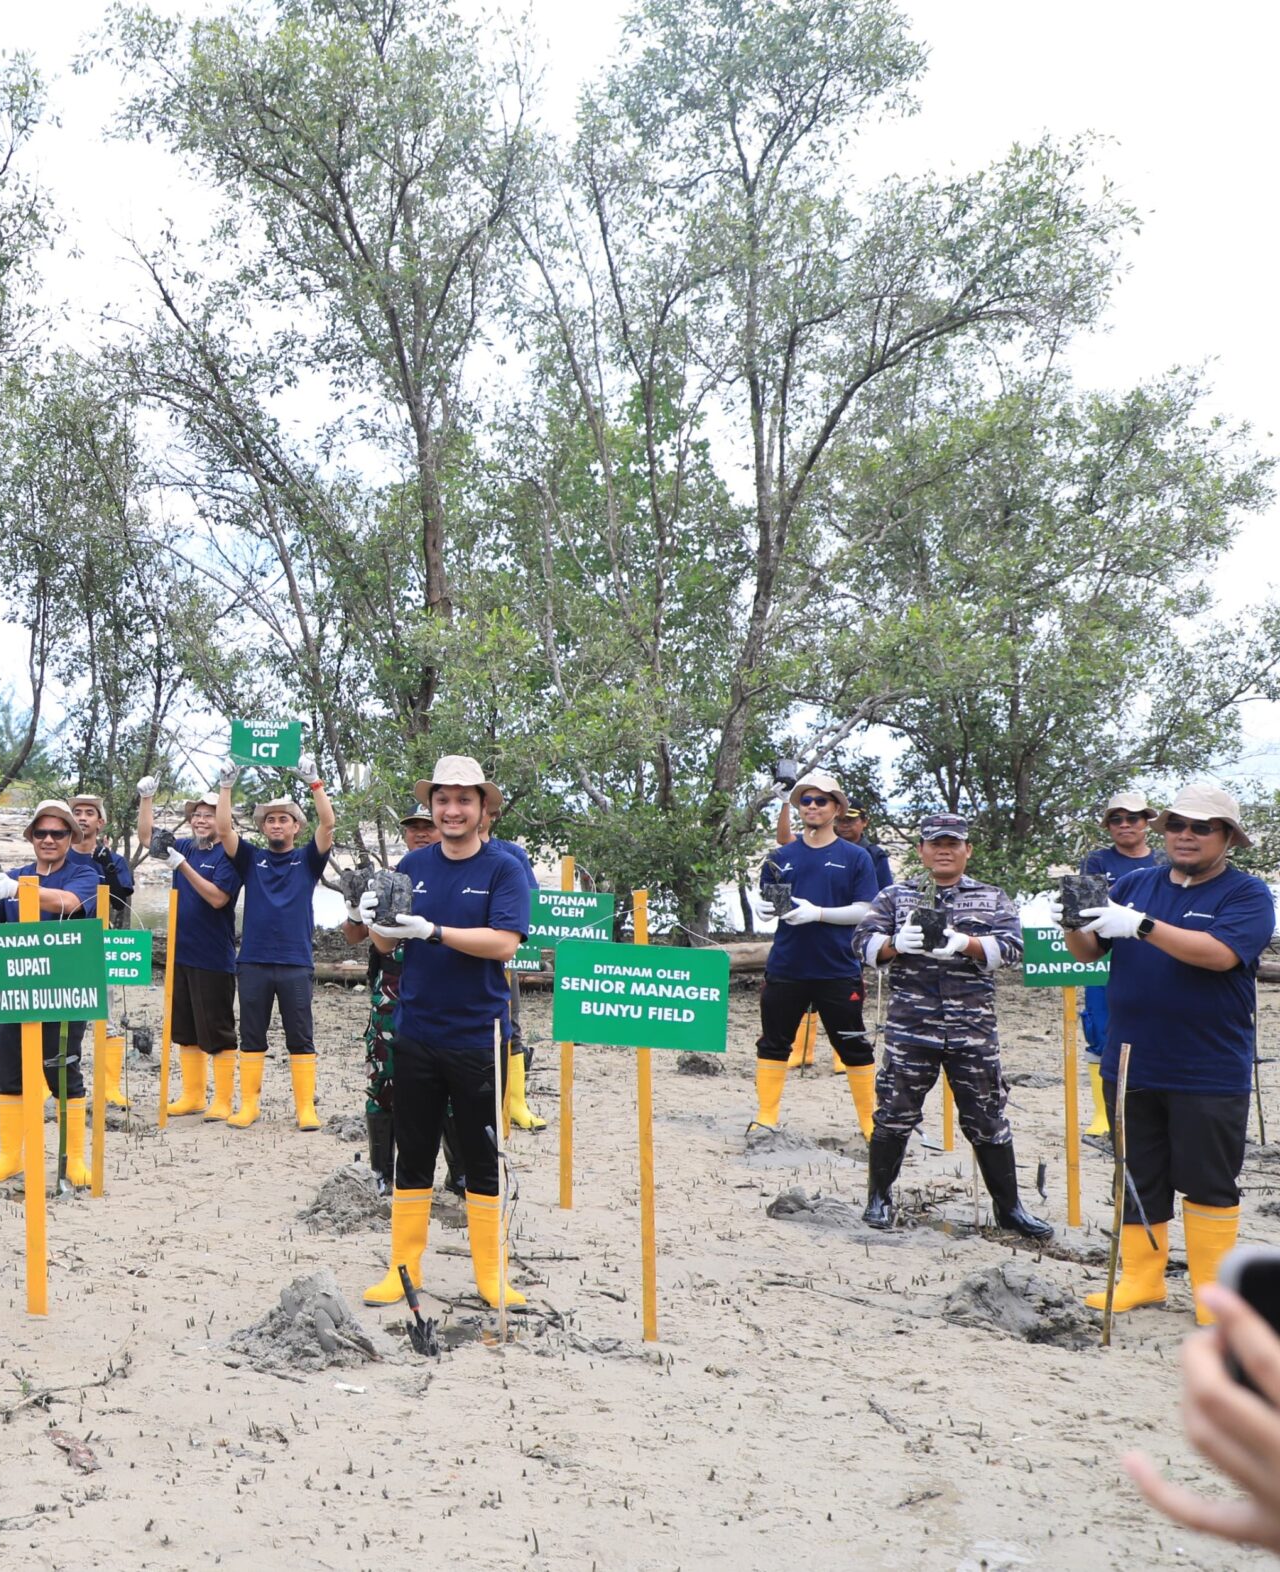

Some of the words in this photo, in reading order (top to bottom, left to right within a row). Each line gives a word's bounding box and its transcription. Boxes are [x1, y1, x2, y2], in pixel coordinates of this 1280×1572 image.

[252, 729, 278, 738] OLEH
[251, 742, 280, 758] ICT
[538, 894, 597, 907] DITANAM
[551, 906, 585, 918] OLEH
[43, 932, 82, 946] OLEH
[112, 936, 135, 945] OLEH
[1037, 929, 1065, 941] DITA
[120, 951, 142, 962] OPS
[6, 957, 51, 977] BUPATI
[108, 967, 139, 978] FIELD
[593, 964, 653, 978] DITANAM
[656, 968, 691, 981] OLEH
[560, 976, 625, 994] SENIOR
[630, 982, 721, 1001] MANAGER
[32, 987, 98, 1011] BULUNGAN
[580, 1001, 642, 1019] BUNYU
[648, 1006, 695, 1023] FIELD
